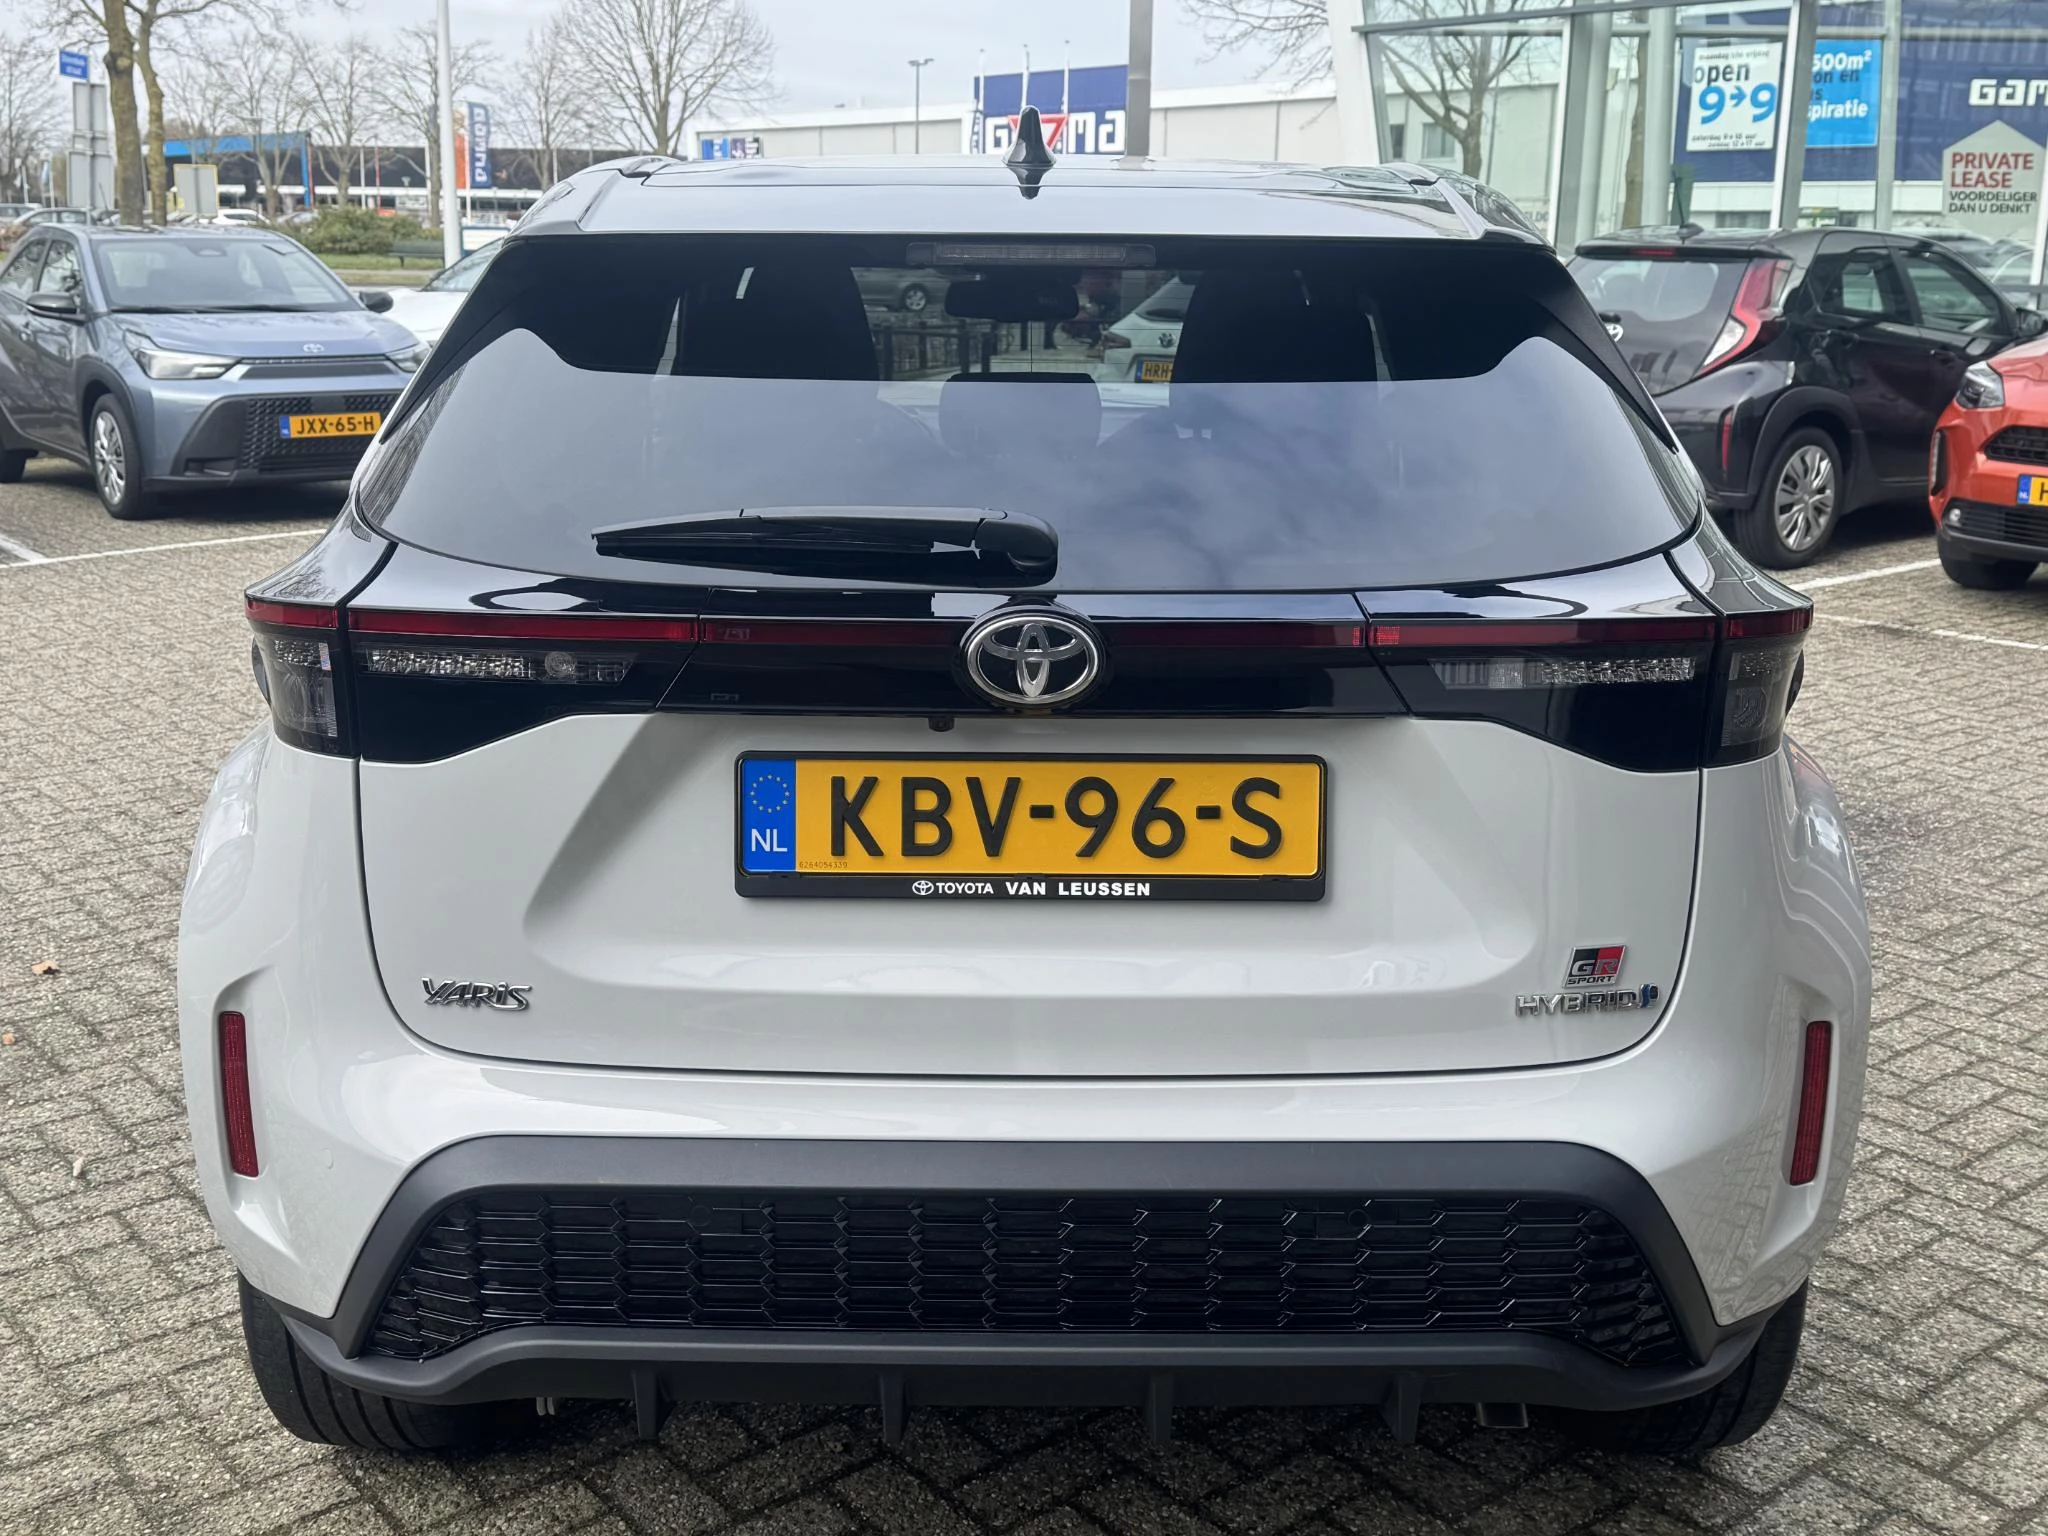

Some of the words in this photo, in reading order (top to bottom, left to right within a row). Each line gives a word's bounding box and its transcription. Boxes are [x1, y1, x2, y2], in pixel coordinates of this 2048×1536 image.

[1694, 64, 1750, 88] open
[1839, 69, 1860, 82] en
[1699, 85, 1725, 125] 9
[1750, 82, 1777, 123] 9
[1952, 152, 2034, 170] PRIVATE
[1950, 171, 2013, 188] LEASE
[1949, 191, 2037, 202] VOORDELIGER
[1949, 202, 1976, 213] DAN
[1978, 203, 1988, 213] U
[1990, 203, 2031, 213] DENKT
[297, 416, 375, 434] JXX-65-H
[831, 776, 1283, 860] KBV-96-S
[751, 828, 788, 852] NL
[936, 882, 994, 895] TOYOTA
[1006, 882, 1046, 896] VAN
[1059, 882, 1150, 896] LEUSSEN
[1571, 959, 1618, 976] GR
[1567, 975, 1615, 985] SPORT
[1516, 989, 1637, 1016] HYBRID
